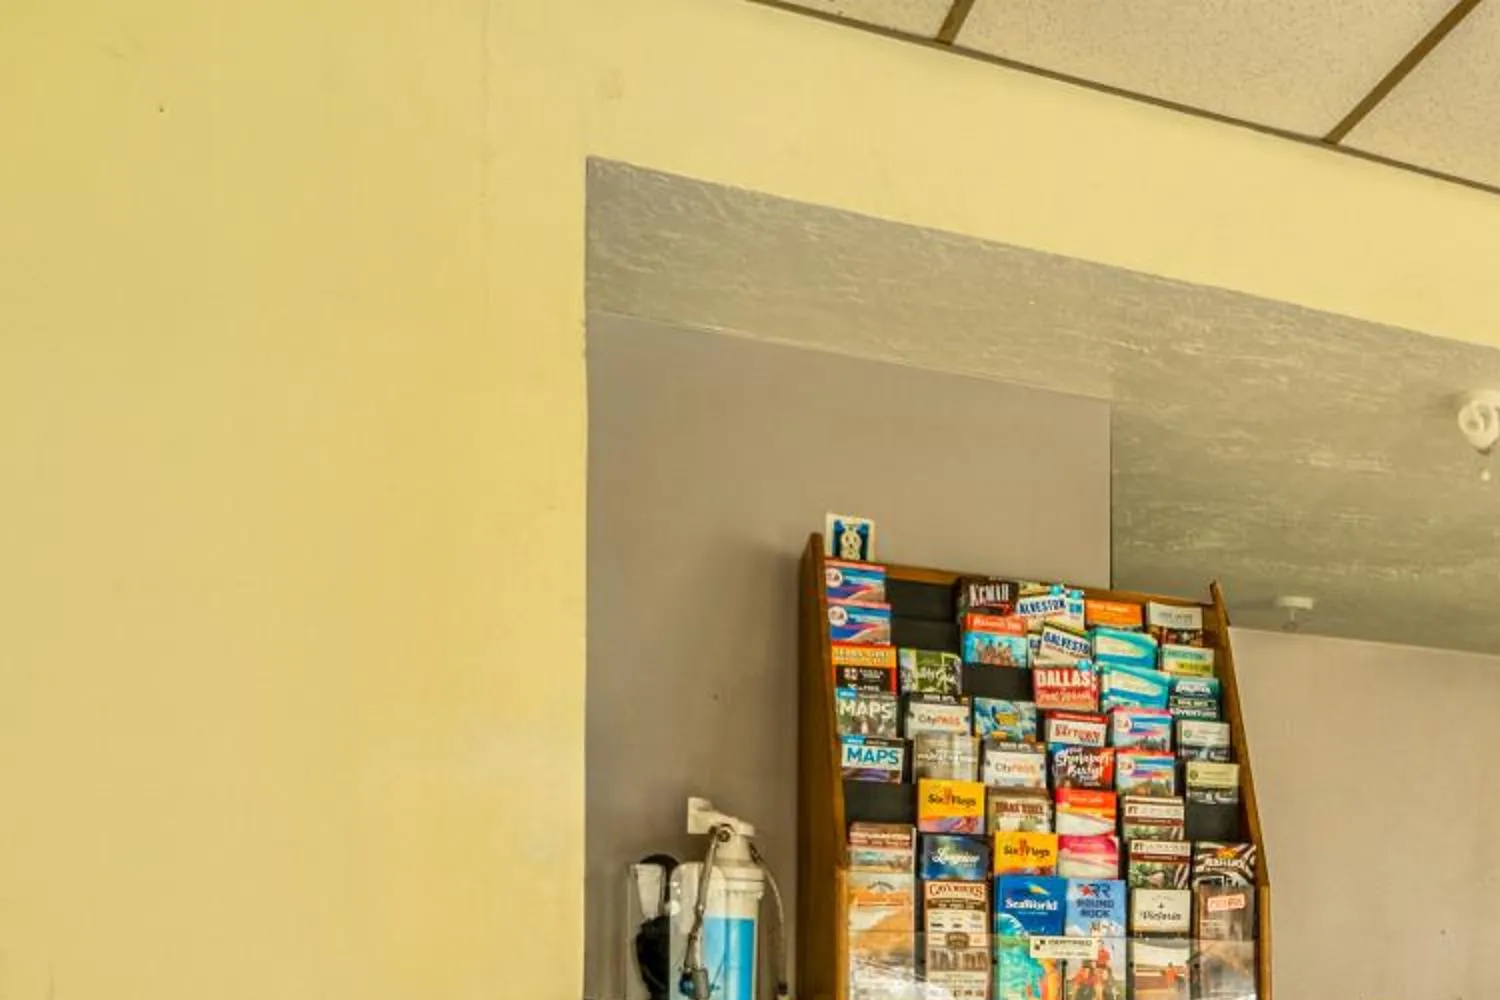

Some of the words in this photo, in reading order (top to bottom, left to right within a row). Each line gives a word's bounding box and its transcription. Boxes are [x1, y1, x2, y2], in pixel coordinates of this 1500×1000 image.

[1037, 669, 1091, 687] DALLAS
[839, 700, 894, 720] MAPS
[846, 747, 899, 765] MAPS
[928, 792, 944, 804] Six
[951, 794, 977, 808] Flags
[1003, 844, 1019, 855] Six
[1025, 845, 1051, 859] Flags
[1004, 898, 1059, 912] SeaWorld
[1076, 899, 1115, 910] ROUND
[1080, 909, 1112, 920] ROCK
